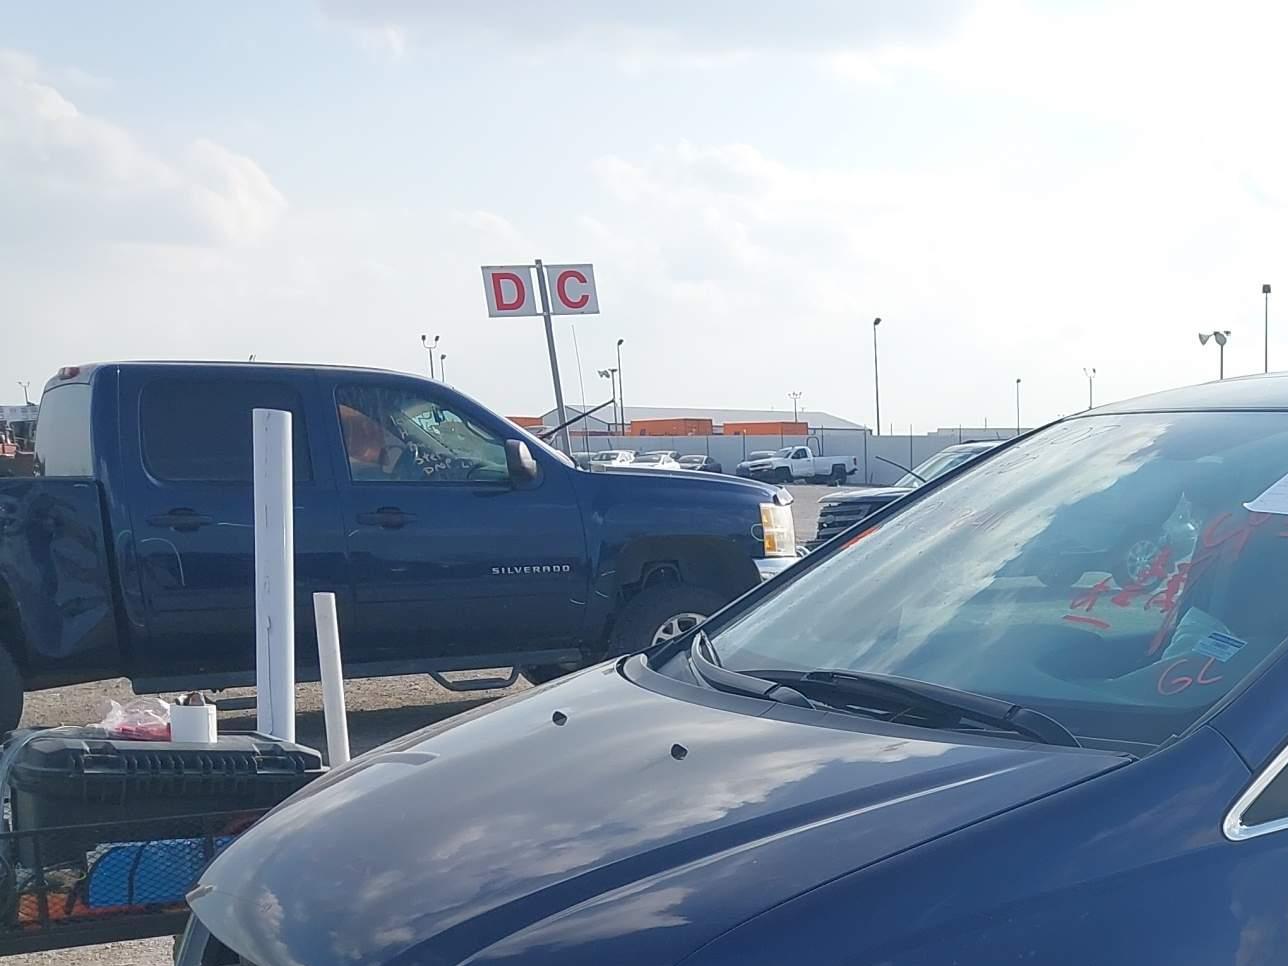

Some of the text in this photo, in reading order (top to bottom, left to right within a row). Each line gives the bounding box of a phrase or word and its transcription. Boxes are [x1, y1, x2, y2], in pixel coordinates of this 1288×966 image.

[491, 270, 590, 311] D C
[492, 564, 570, 575] SILVERADO
